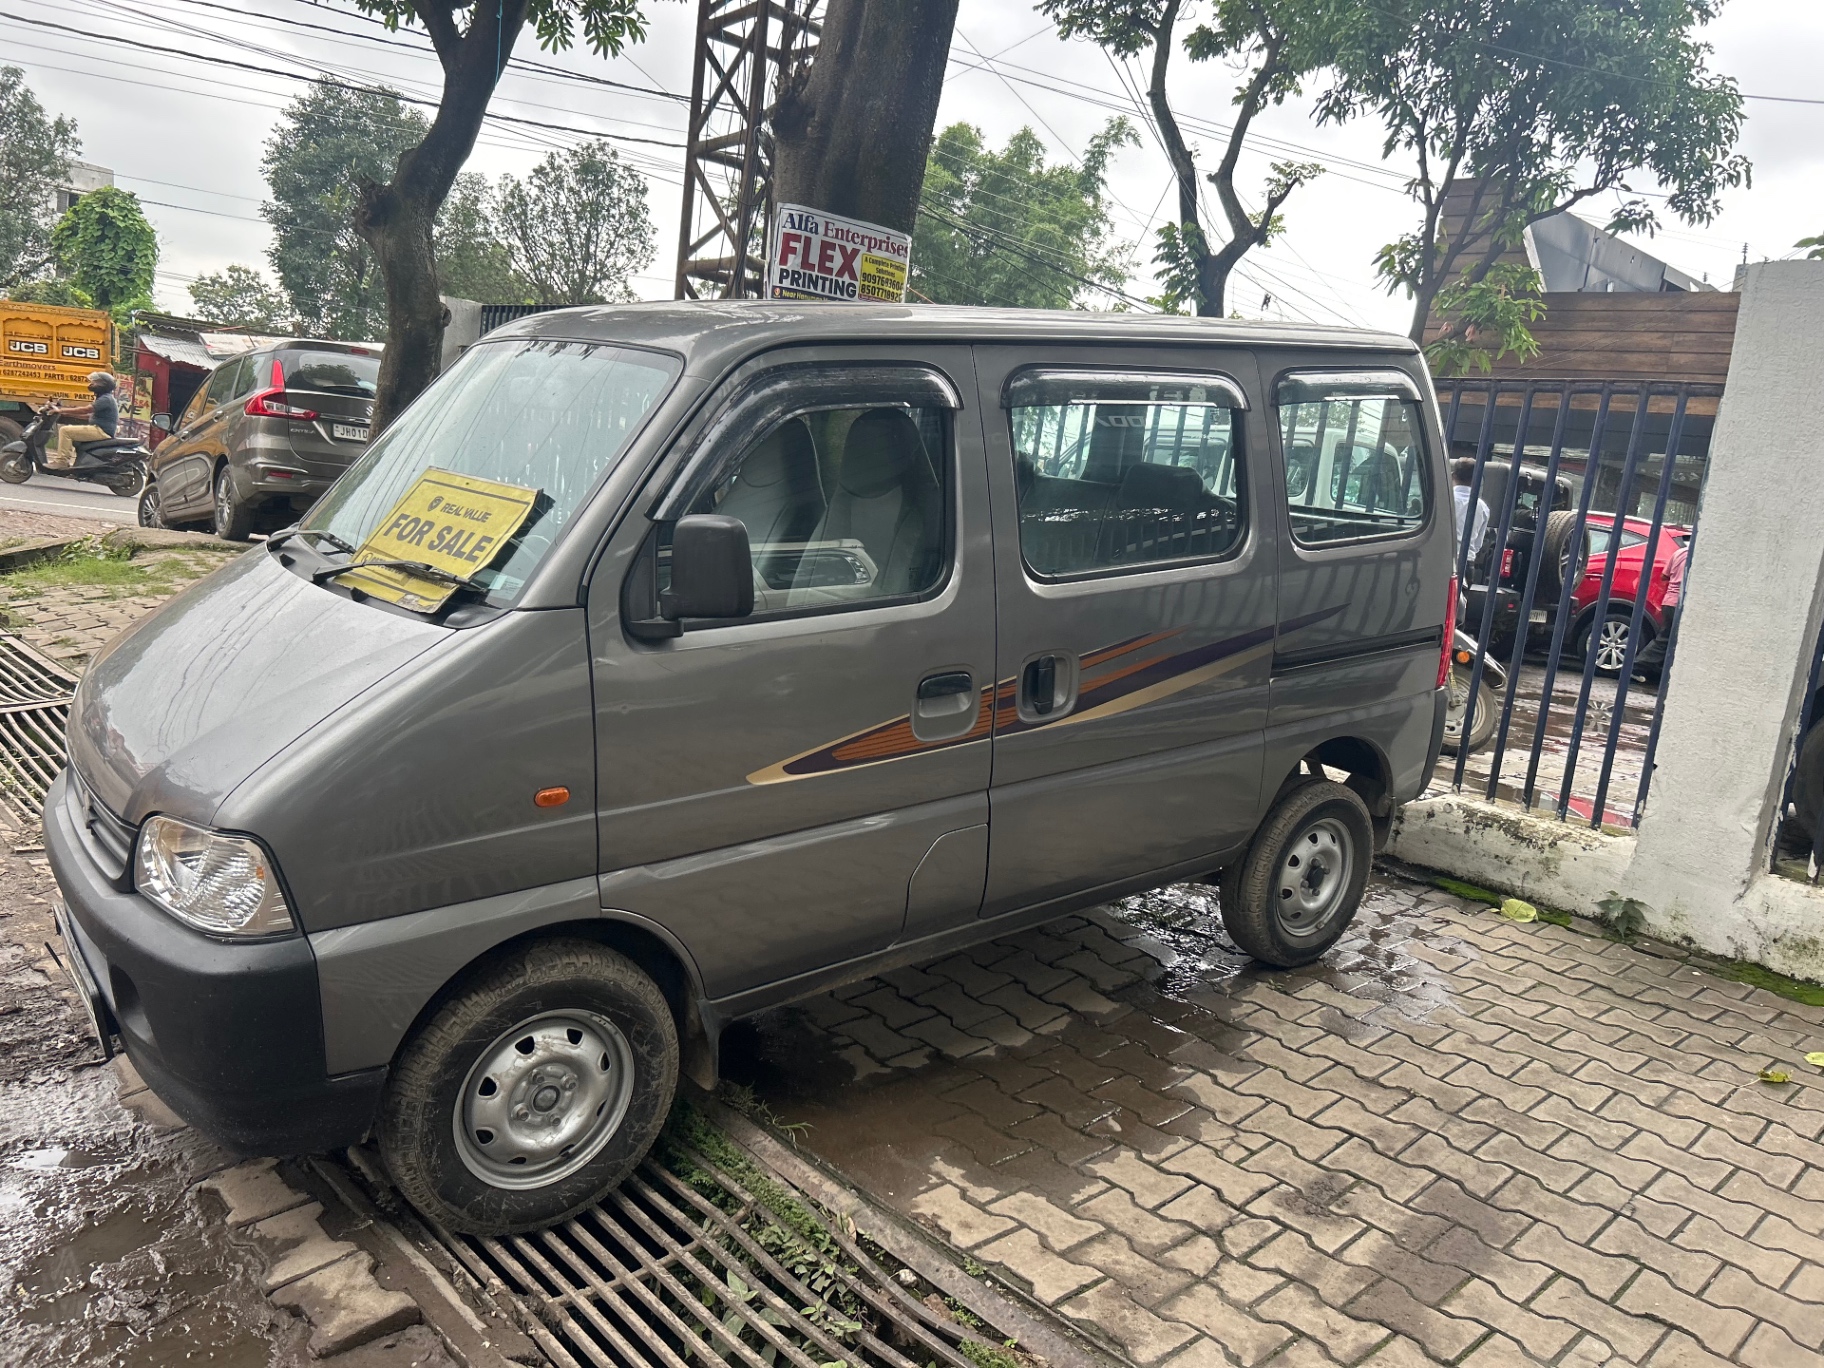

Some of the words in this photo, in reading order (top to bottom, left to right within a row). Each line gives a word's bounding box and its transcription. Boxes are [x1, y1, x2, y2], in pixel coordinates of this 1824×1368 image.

[782, 212, 819, 236] Alfa
[822, 220, 908, 259] Enterprises
[779, 232, 860, 282] FLEX
[869, 257, 890, 268] Complete
[778, 268, 857, 299] PRINTING
[782, 289, 796, 299] Near
[9, 341, 48, 354] JCB
[63, 346, 99, 359] JCB
[440, 503, 464, 517] REAL
[463, 507, 492, 523] VALUE
[383, 513, 435, 547] FOR
[427, 525, 494, 563] SALE
